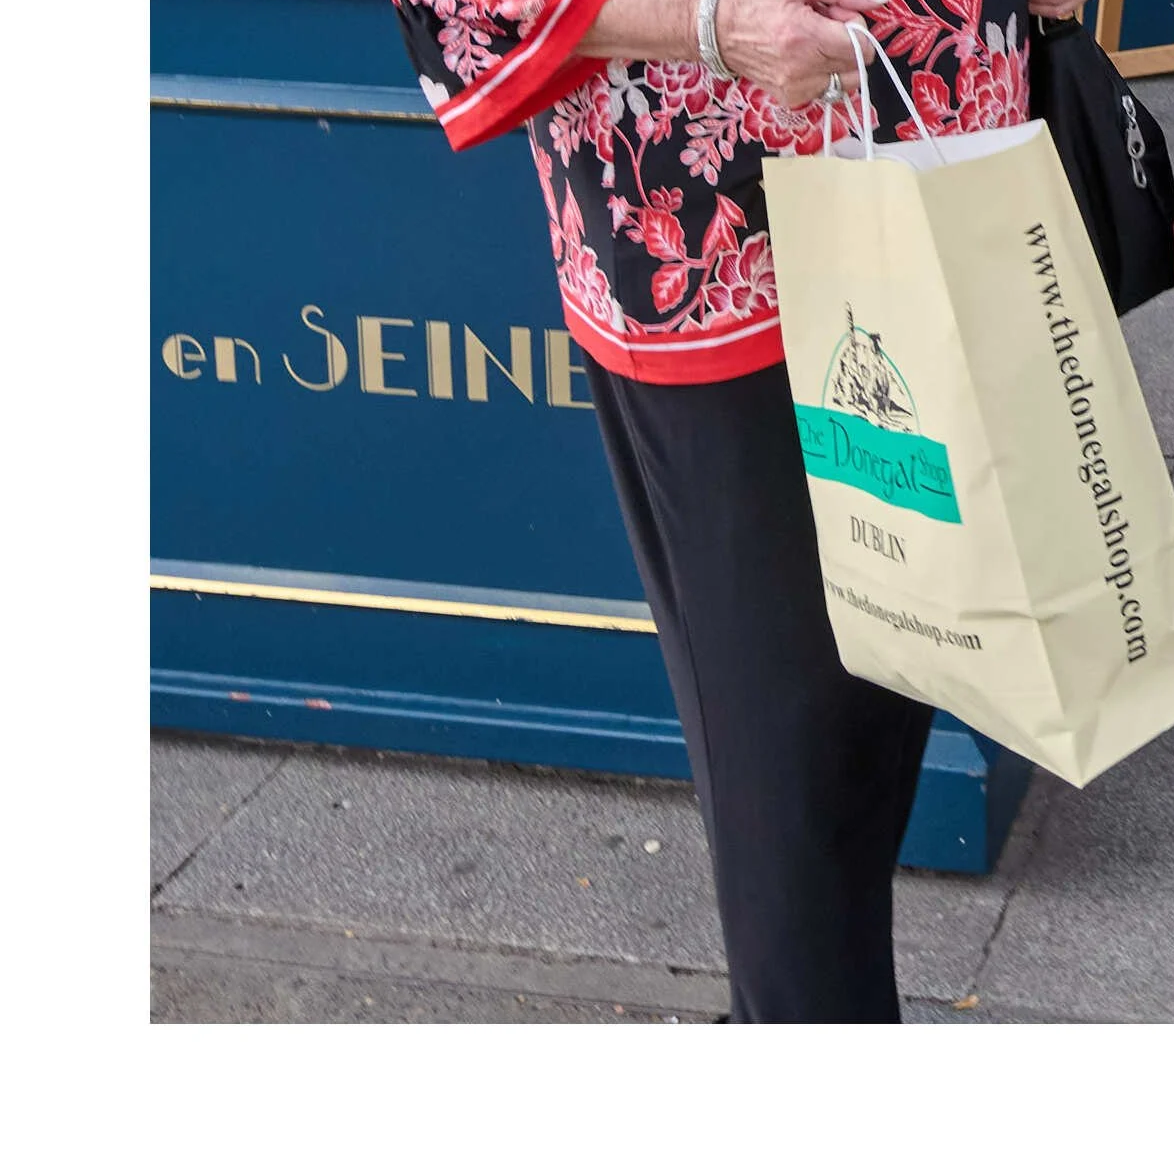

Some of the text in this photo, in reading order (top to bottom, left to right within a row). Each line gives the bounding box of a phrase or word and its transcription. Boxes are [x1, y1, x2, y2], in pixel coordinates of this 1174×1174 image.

[161, 304, 596, 410] en SEINE
[828, 416, 920, 500] Donegal
[1023, 221, 1148, 663] www.thedonegalshop.com
[850, 515, 908, 563] DUBLIN
